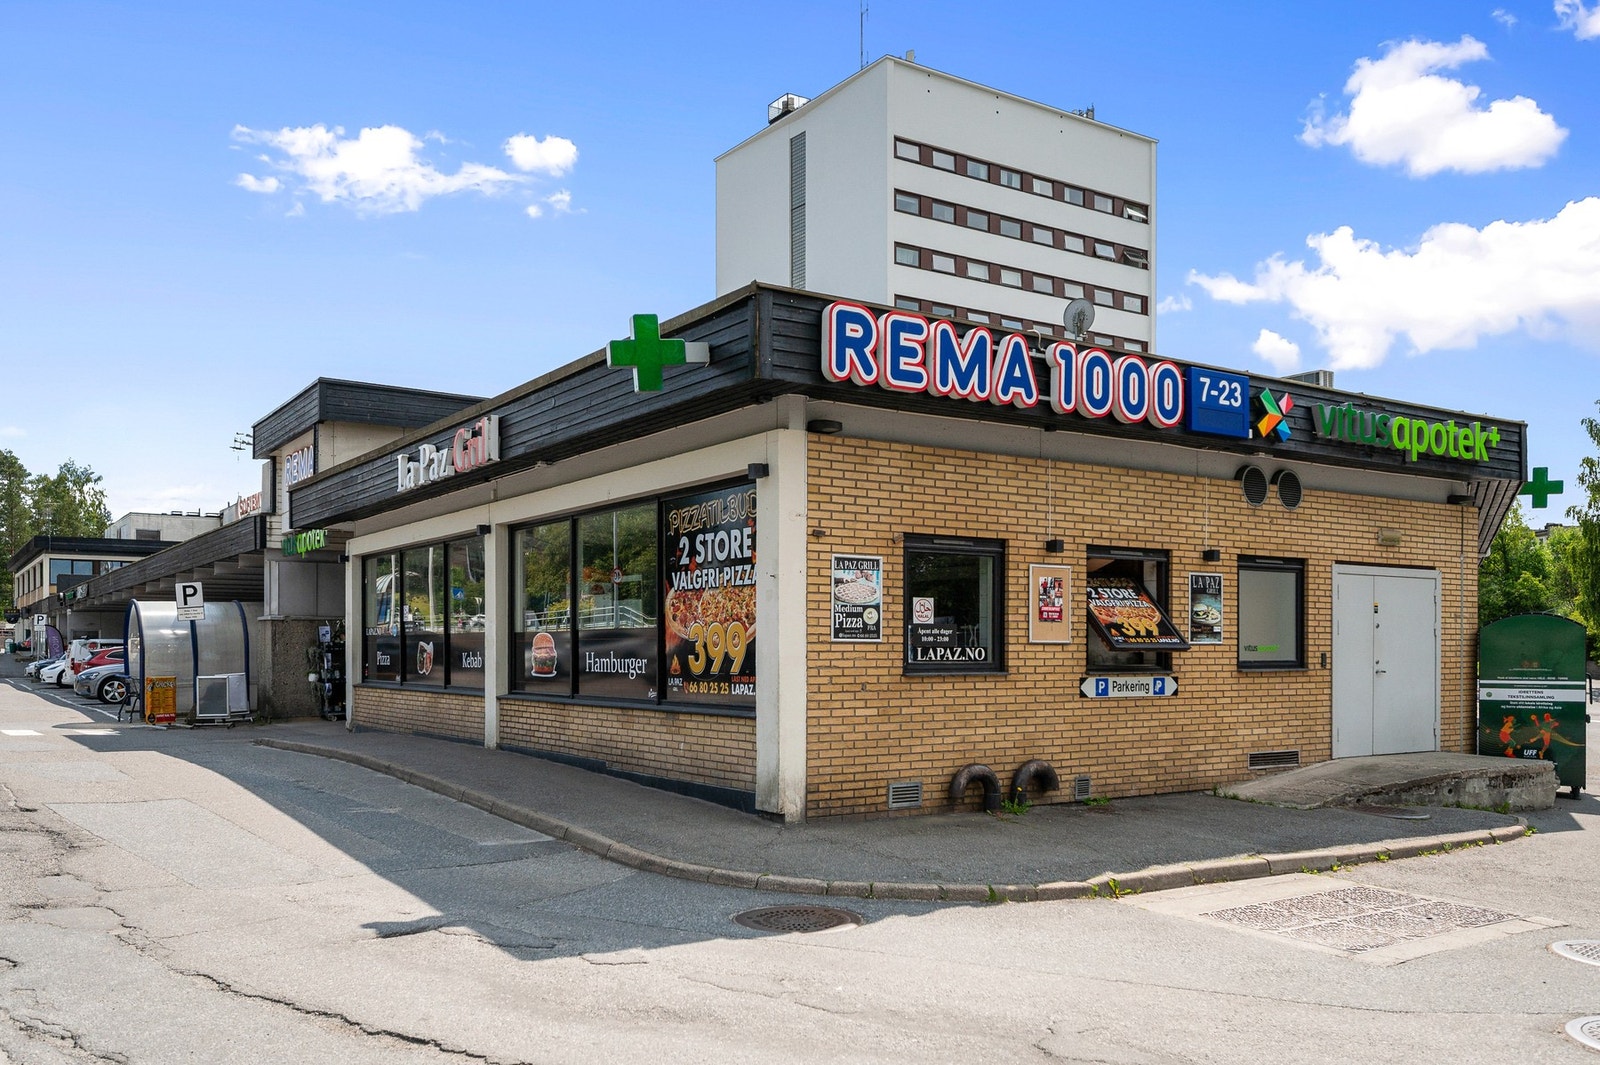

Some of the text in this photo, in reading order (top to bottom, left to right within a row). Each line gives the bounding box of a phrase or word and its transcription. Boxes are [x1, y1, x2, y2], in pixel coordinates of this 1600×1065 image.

[821, 301, 1184, 428] REMA 1000
[1200, 377, 1242, 407] 7-23
[397, 415, 500, 492] La Paz Grill
[285, 445, 314, 486] REMA
[679, 527, 752, 565] 2 STORE
[834, 560, 879, 570] LA PAZ GRILL
[671, 567, 719, 591] VALGFRI
[1192, 575, 1220, 589] LA PAZ
[182, 584, 198, 606] P
[1087, 588, 1138, 599] 2 STORE
[834, 604, 863, 612] Medium
[1125, 600, 1152, 608] PIZZA
[36, 615, 44, 625] P
[834, 613, 863, 628] Pizza
[1117, 617, 1159, 636] 399
[688, 621, 747, 675] 399
[917, 647, 986, 661] LAPAZ.NO
[376, 651, 391, 666] Pizza
[462, 652, 482, 669] Kebab
[585, 651, 647, 680] Hamburger
[689, 682, 698, 694] 66
[699, 682, 708, 694] 80
[709, 682, 719, 694] 25
[720, 682, 729, 695] 25
[1112, 680, 1150, 694] Parkering
